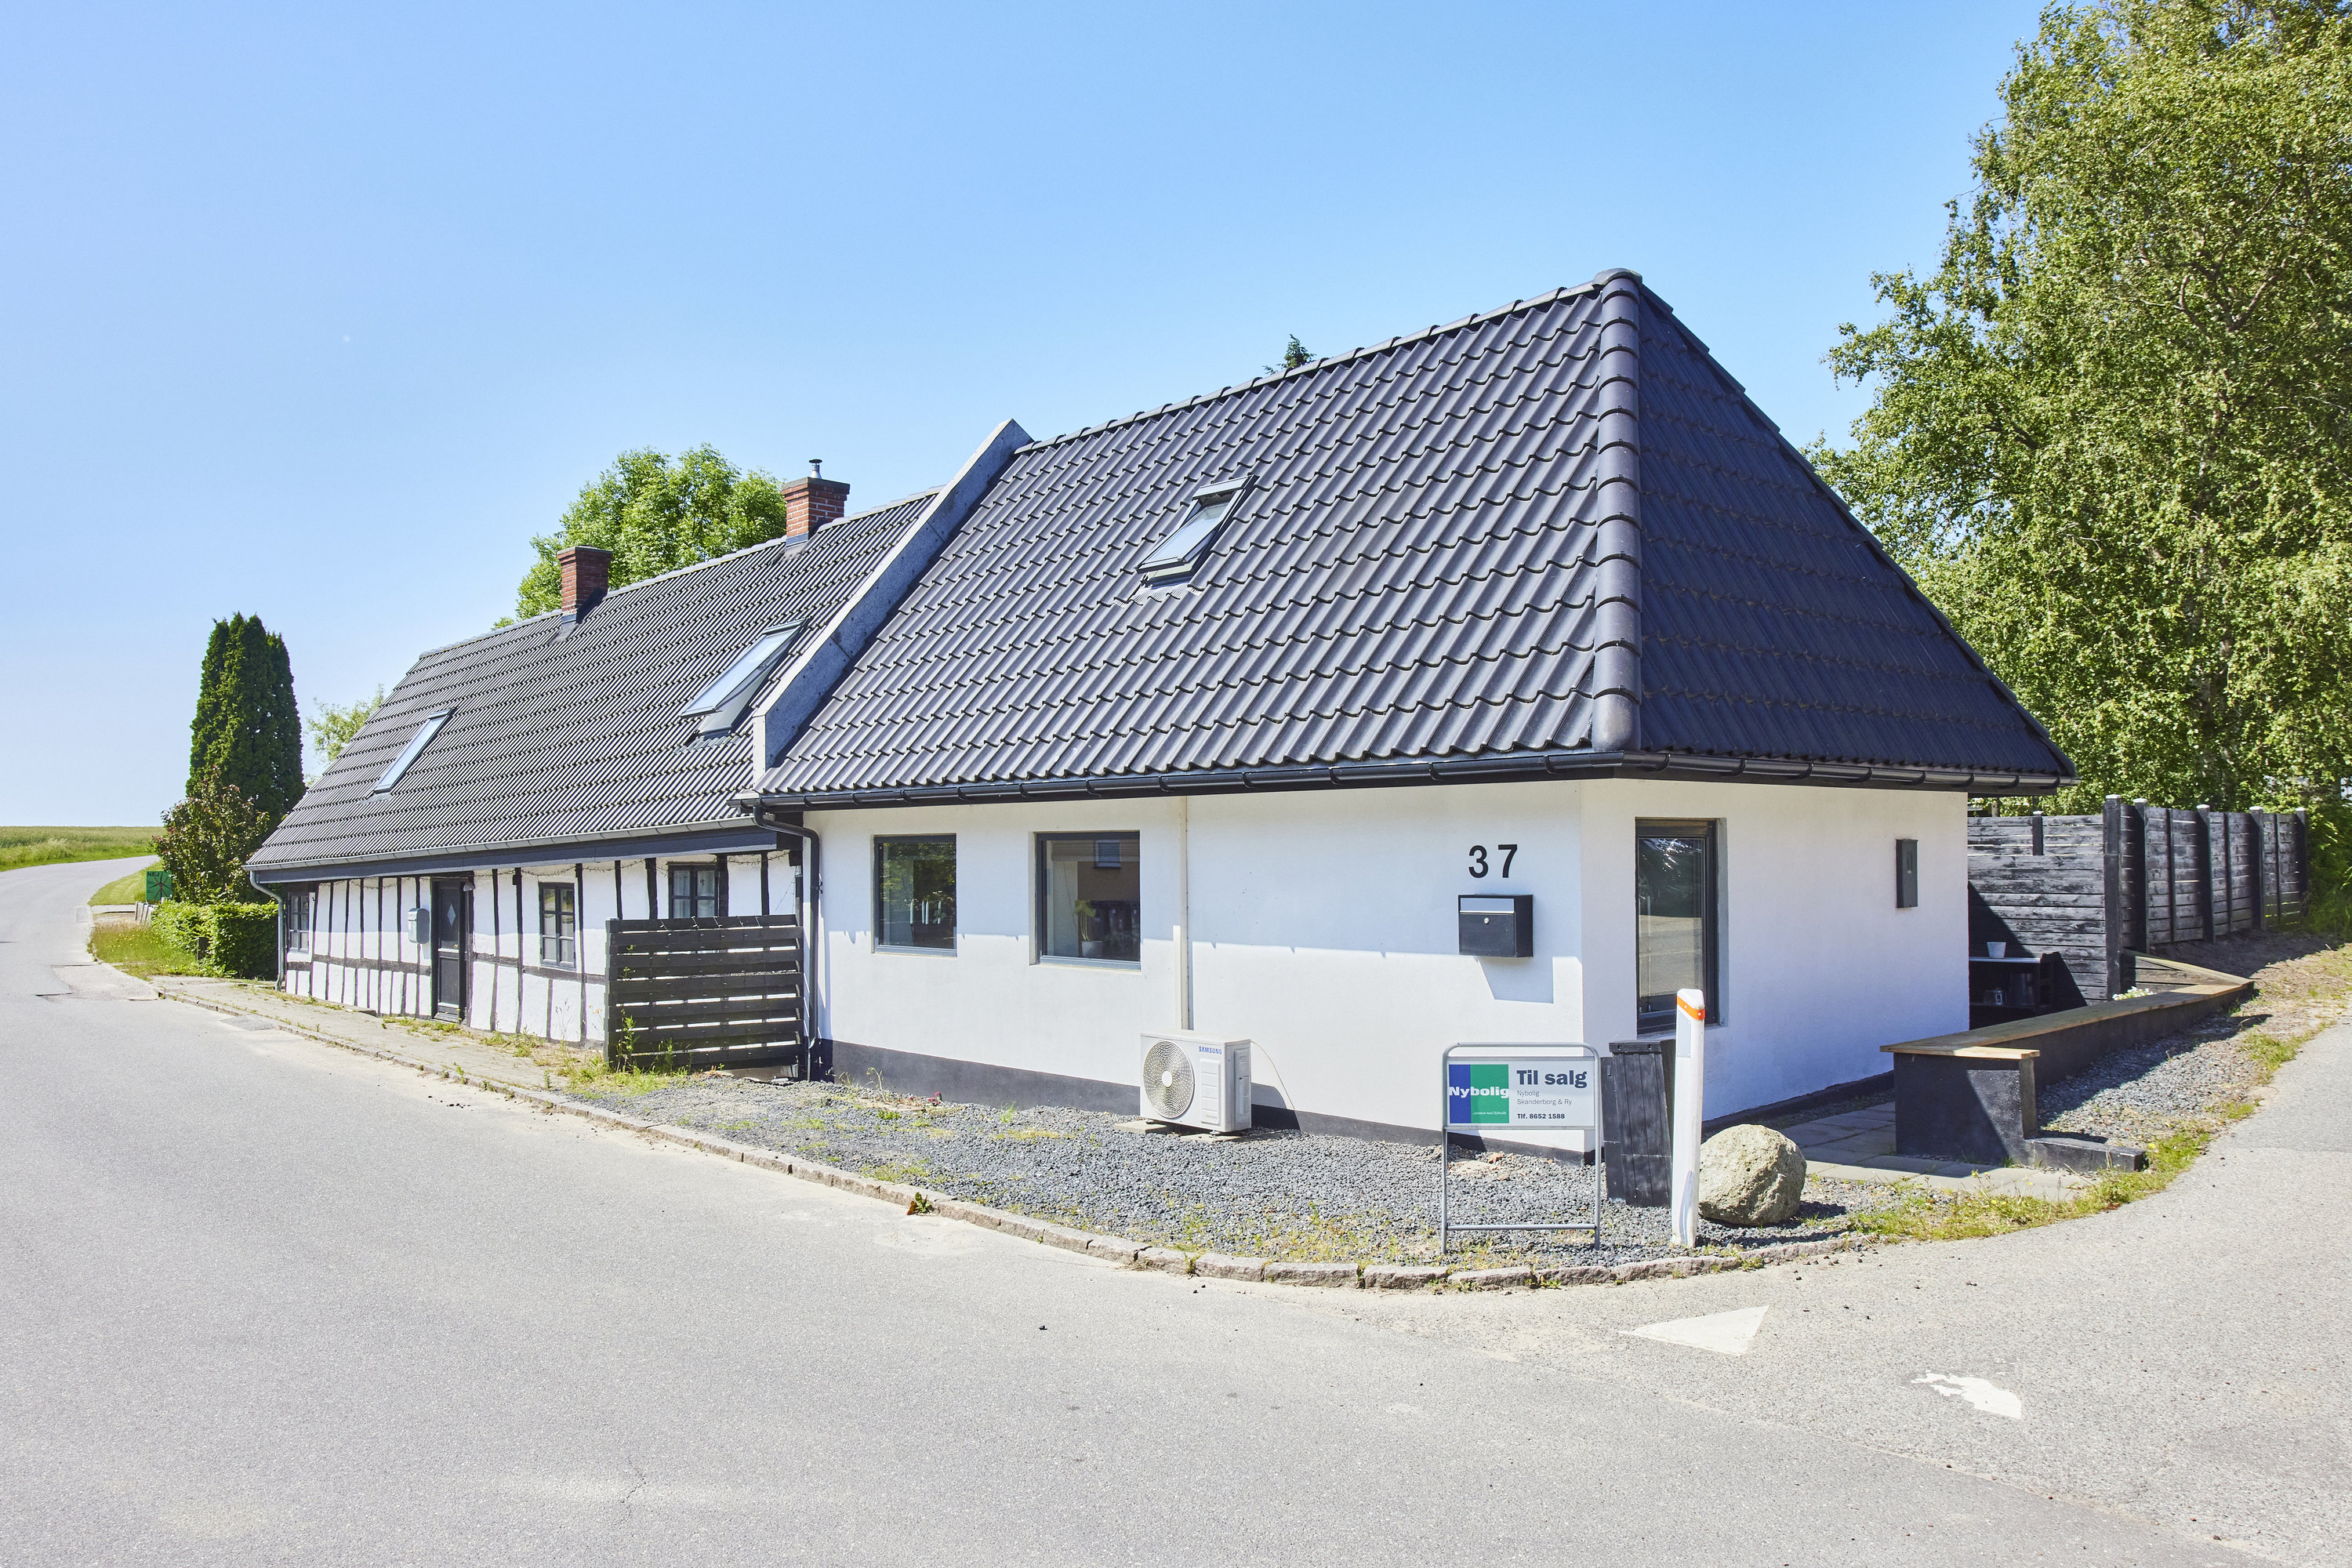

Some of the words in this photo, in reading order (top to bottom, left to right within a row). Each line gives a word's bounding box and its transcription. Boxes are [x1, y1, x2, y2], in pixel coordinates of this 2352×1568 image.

[1468, 844, 1518, 878] 37
[1199, 1046, 1222, 1054] SAMSUNG
[1516, 1069, 1538, 1085] Til
[1544, 1069, 1588, 1089] salg
[1449, 1086, 1510, 1099] Nybolig
